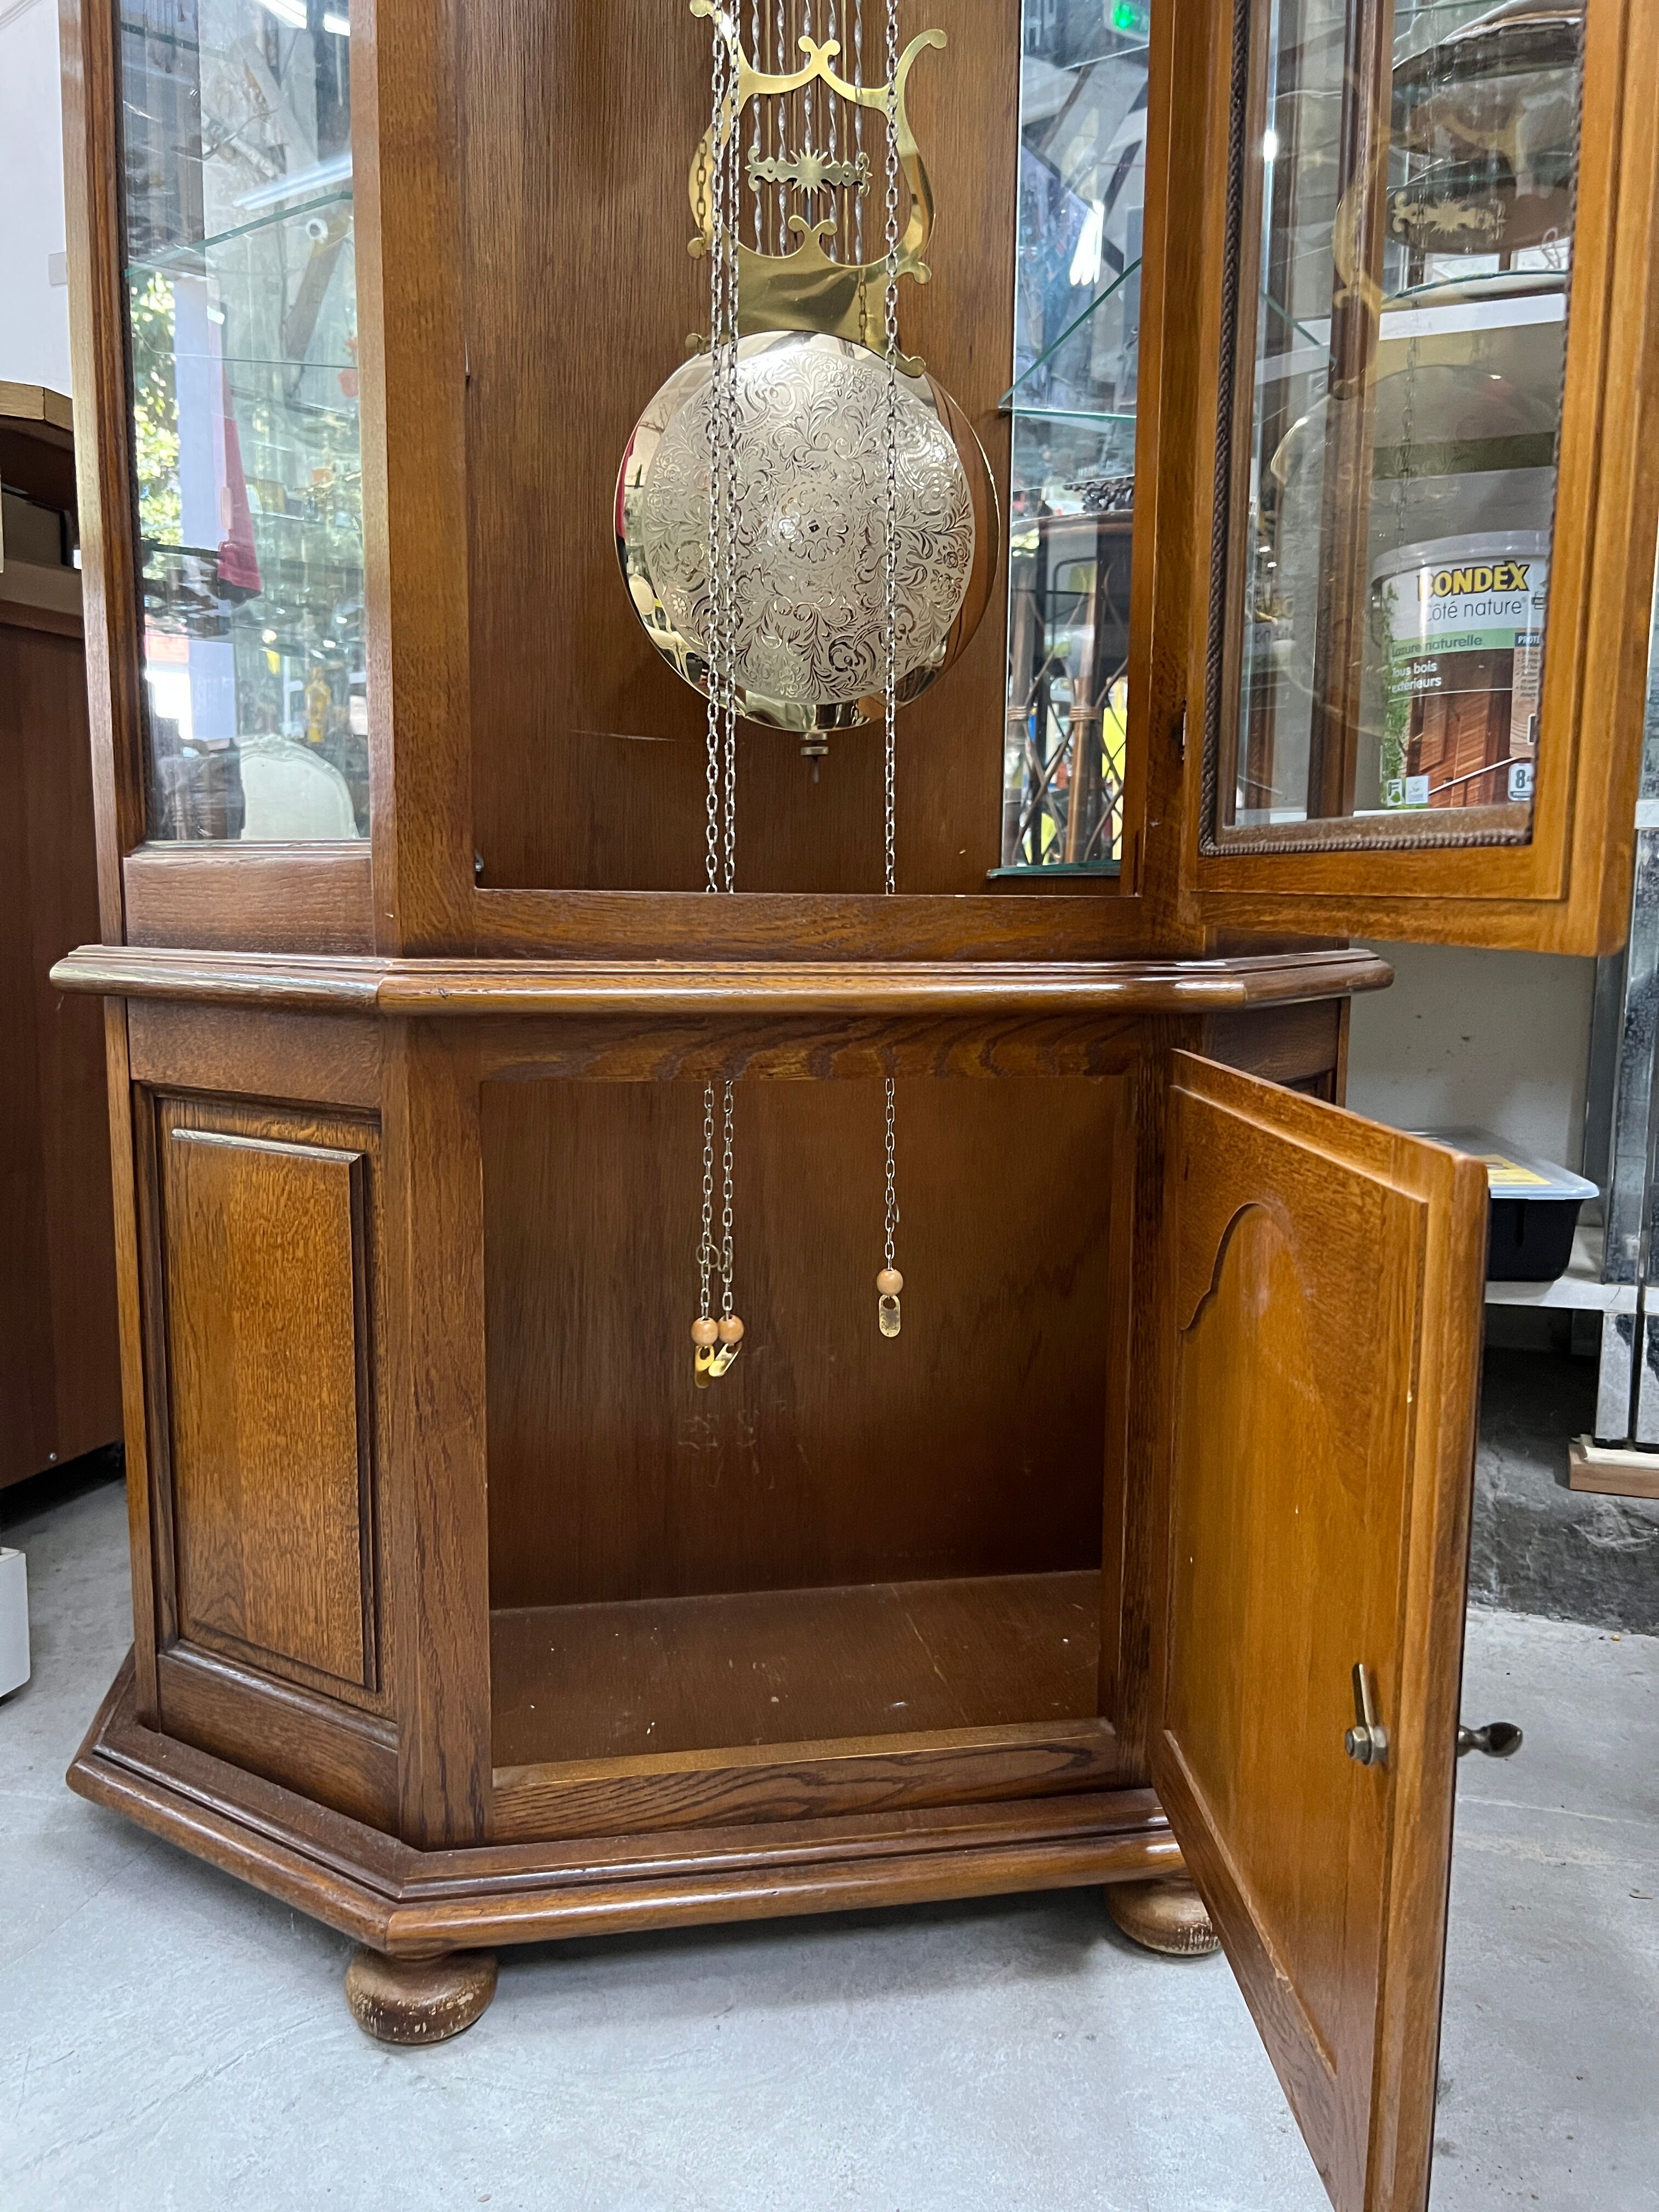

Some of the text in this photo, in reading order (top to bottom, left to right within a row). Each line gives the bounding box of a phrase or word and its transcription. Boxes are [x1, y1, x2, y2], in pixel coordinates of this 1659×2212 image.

[1417, 560, 1530, 601] BONDEX
[1464, 598, 1522, 617] nature
[1425, 634, 1482, 651] naturelle
[1414, 660, 1438, 675] bois
